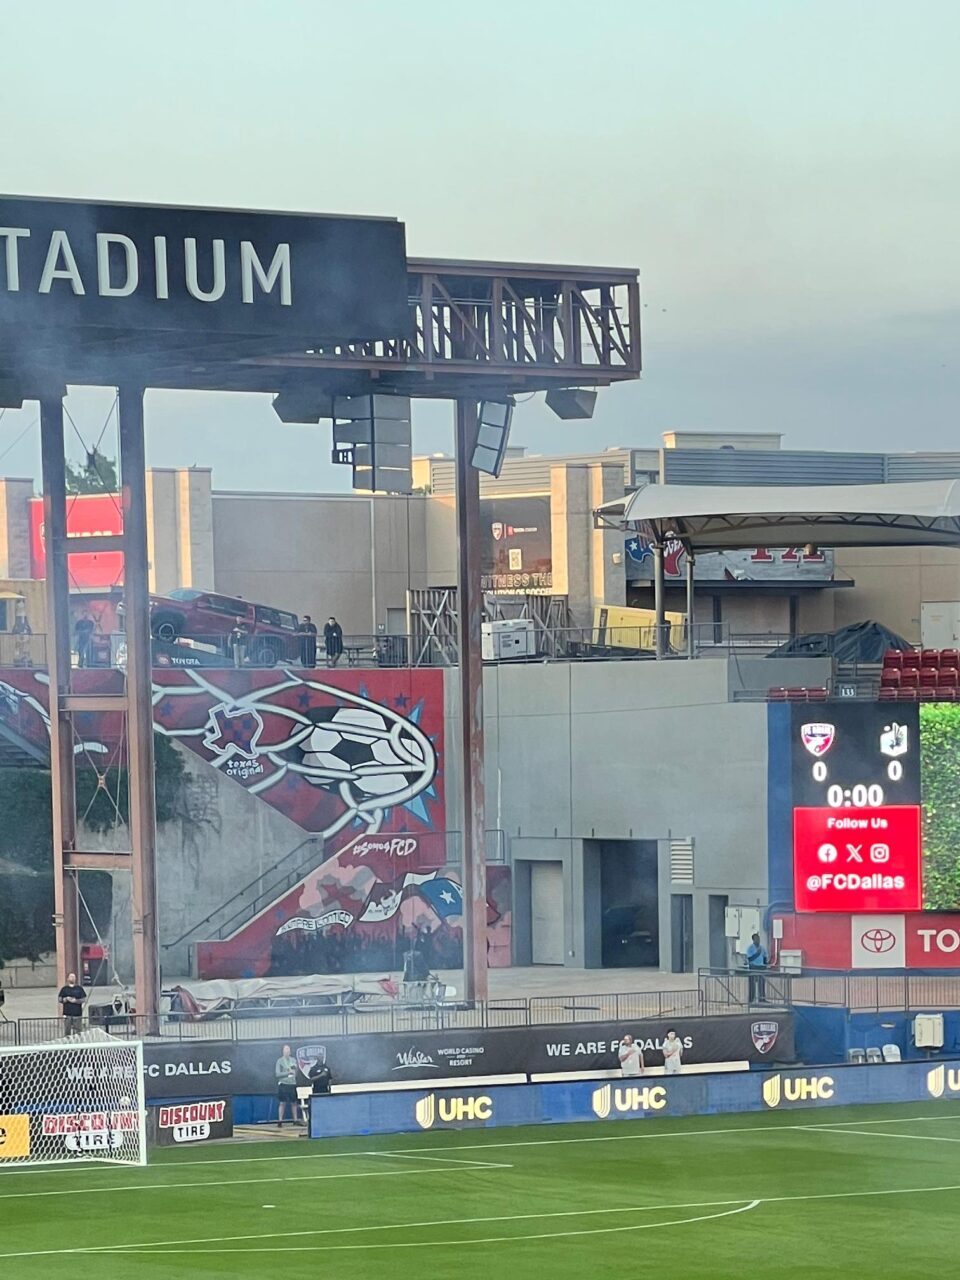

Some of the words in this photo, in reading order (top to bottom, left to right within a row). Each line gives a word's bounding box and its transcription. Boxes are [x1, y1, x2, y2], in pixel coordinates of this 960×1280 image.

[227, 760, 259, 768] texas
[227, 765, 264, 779] original
[812, 761, 827, 782] 0
[887, 760, 903, 781] 0
[827, 784, 884, 807] 0:00
[827, 817, 868, 829] Follow
[871, 817, 888, 829] Us
[806, 873, 905, 890] @FCDallas
[547, 1043, 571, 1057] WE
[575, 1041, 606, 1056] ARE
[634, 1036, 693, 1050] DALS
[165, 1060, 232, 1076] DALLAS
[784, 1076, 834, 1101] UHC
[614, 1086, 667, 1111] UHC
[160, 1101, 225, 1127] DISCOUNT
[439, 1096, 493, 1121] UHC
[72, 1133, 116, 1148] TIRE
[177, 1127, 206, 1139] TIRE
